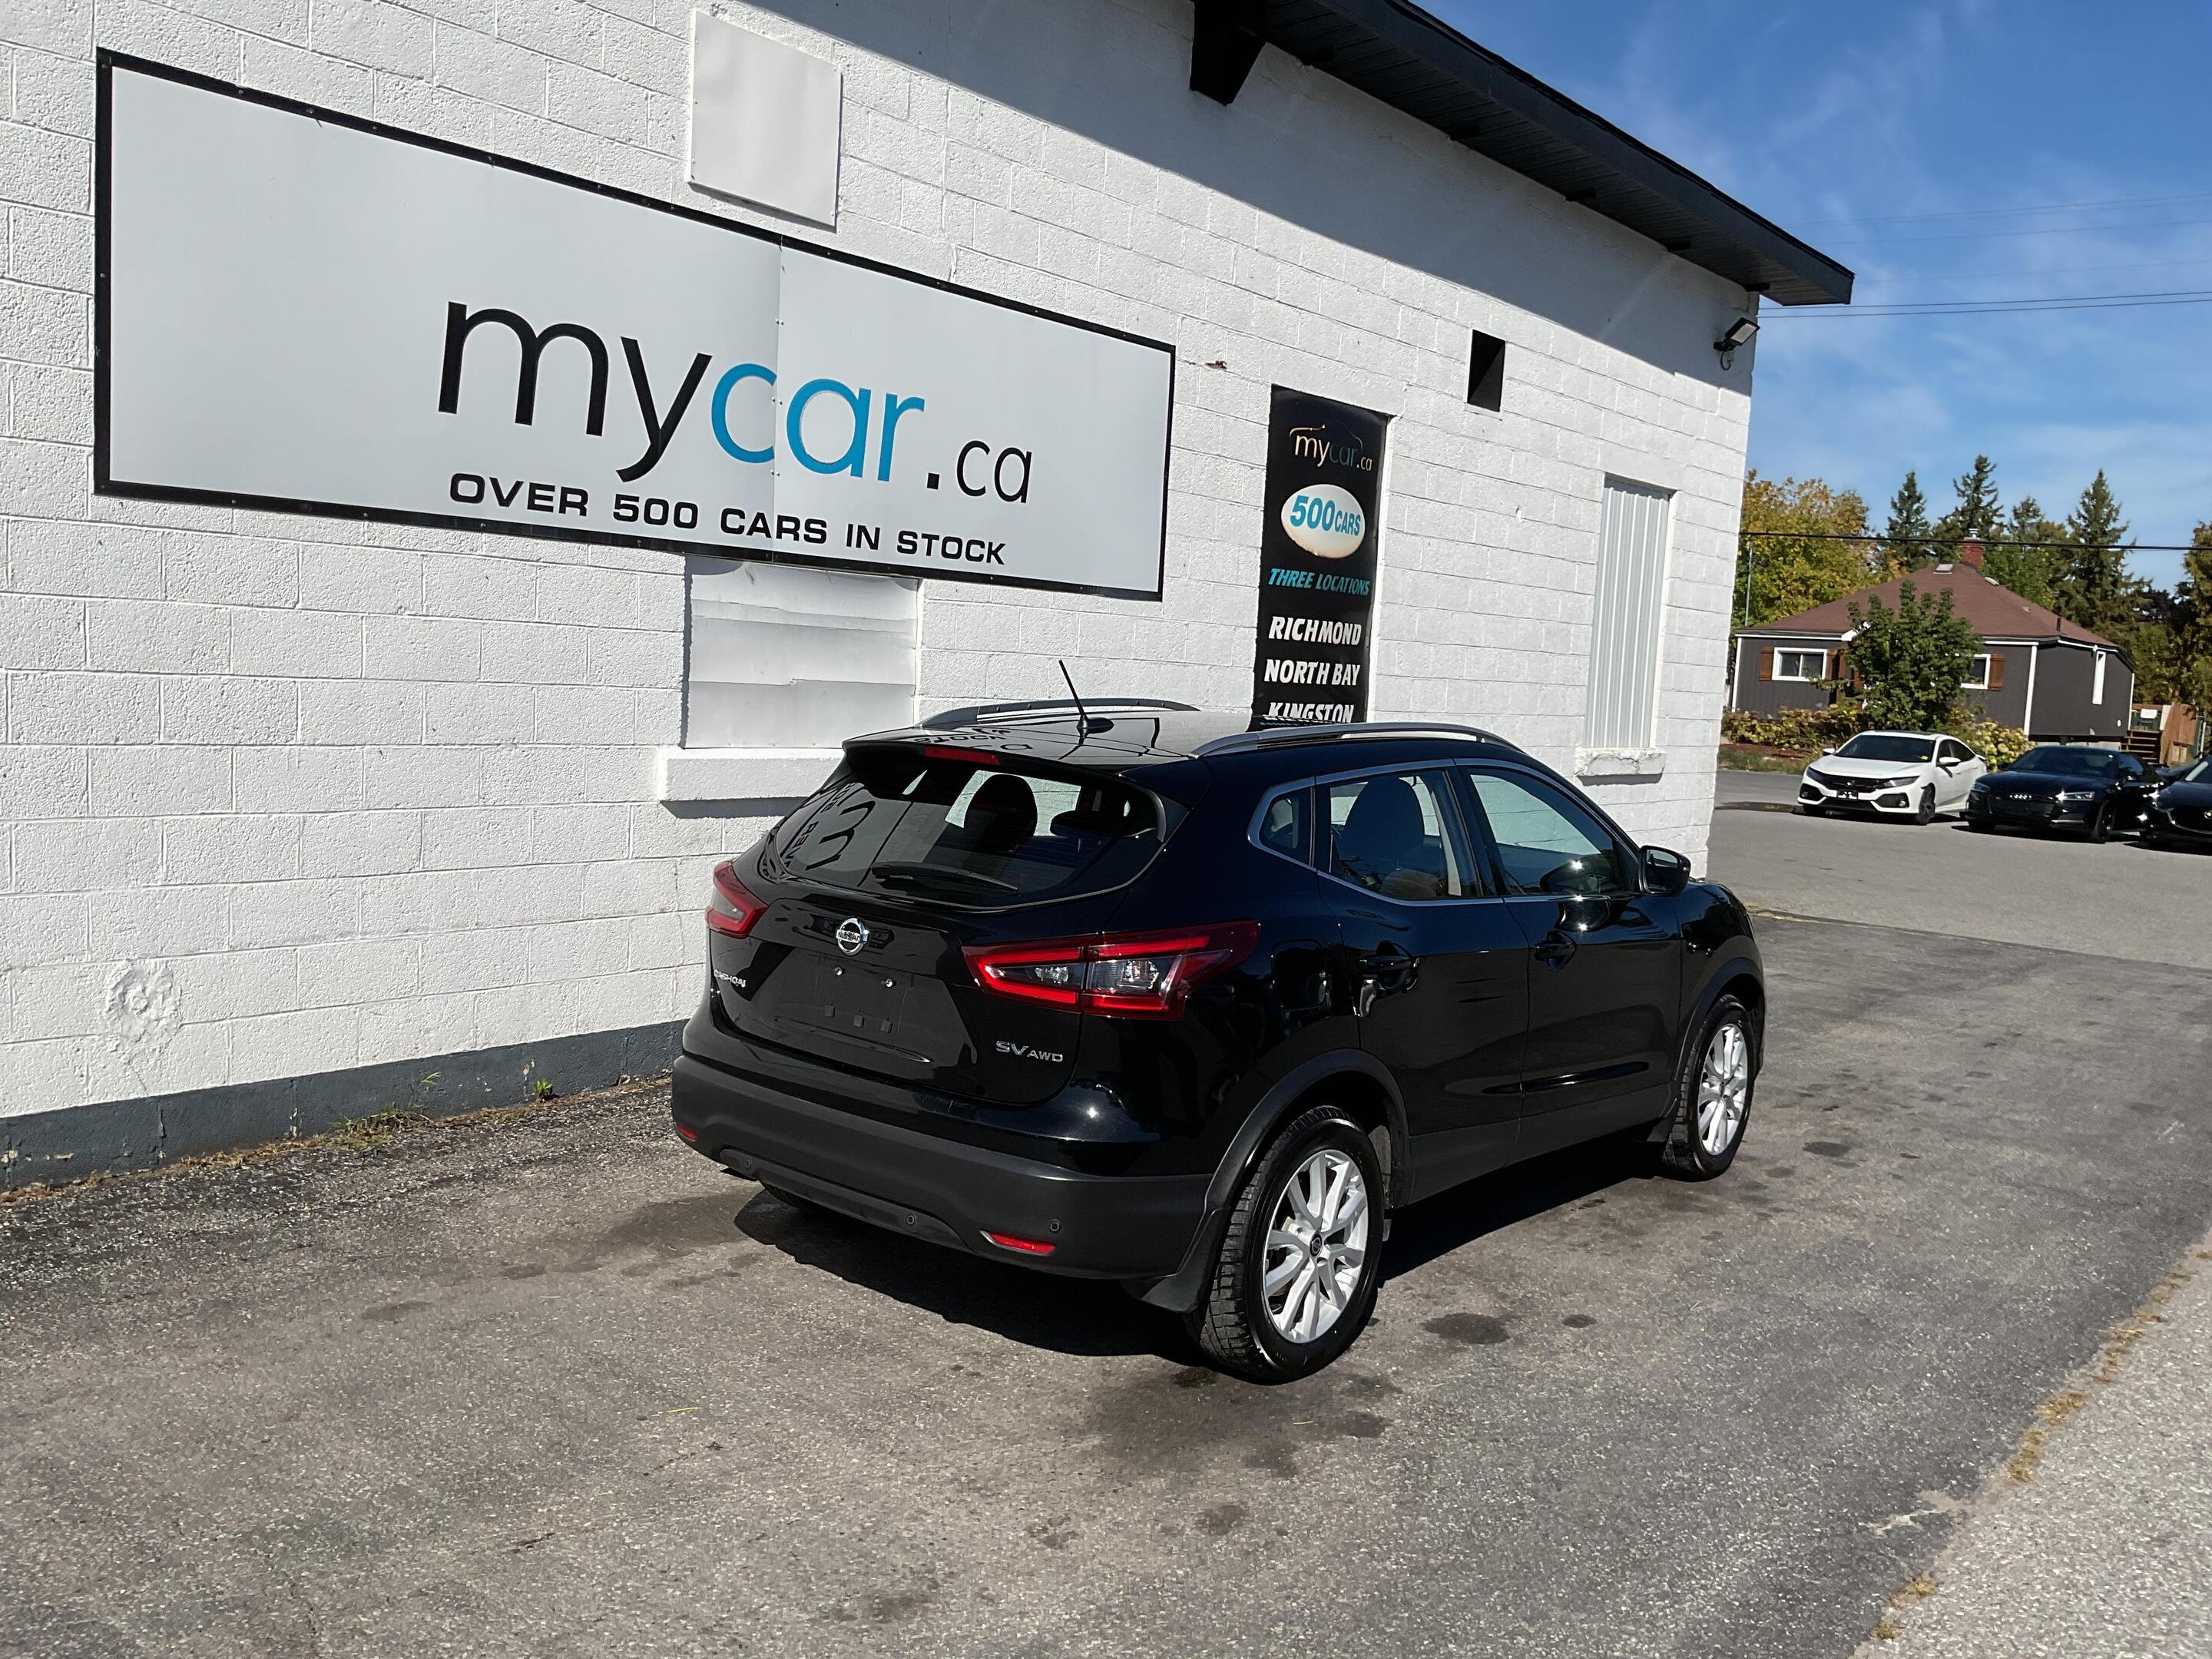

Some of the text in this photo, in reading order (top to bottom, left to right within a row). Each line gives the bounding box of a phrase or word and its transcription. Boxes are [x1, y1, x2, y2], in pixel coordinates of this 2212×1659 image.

[449, 472, 1007, 565] OVER 500 CARS IN STOCK
[1268, 568, 1370, 596] THREE LOCATIONS
[1268, 616, 1362, 645] RICHMOND
[1263, 659, 1361, 686] NORTH BAY
[1268, 702, 1355, 723] KINGSTON
[837, 931, 860, 942] NISSAN
[995, 1040, 1064, 1062] SV AWD
